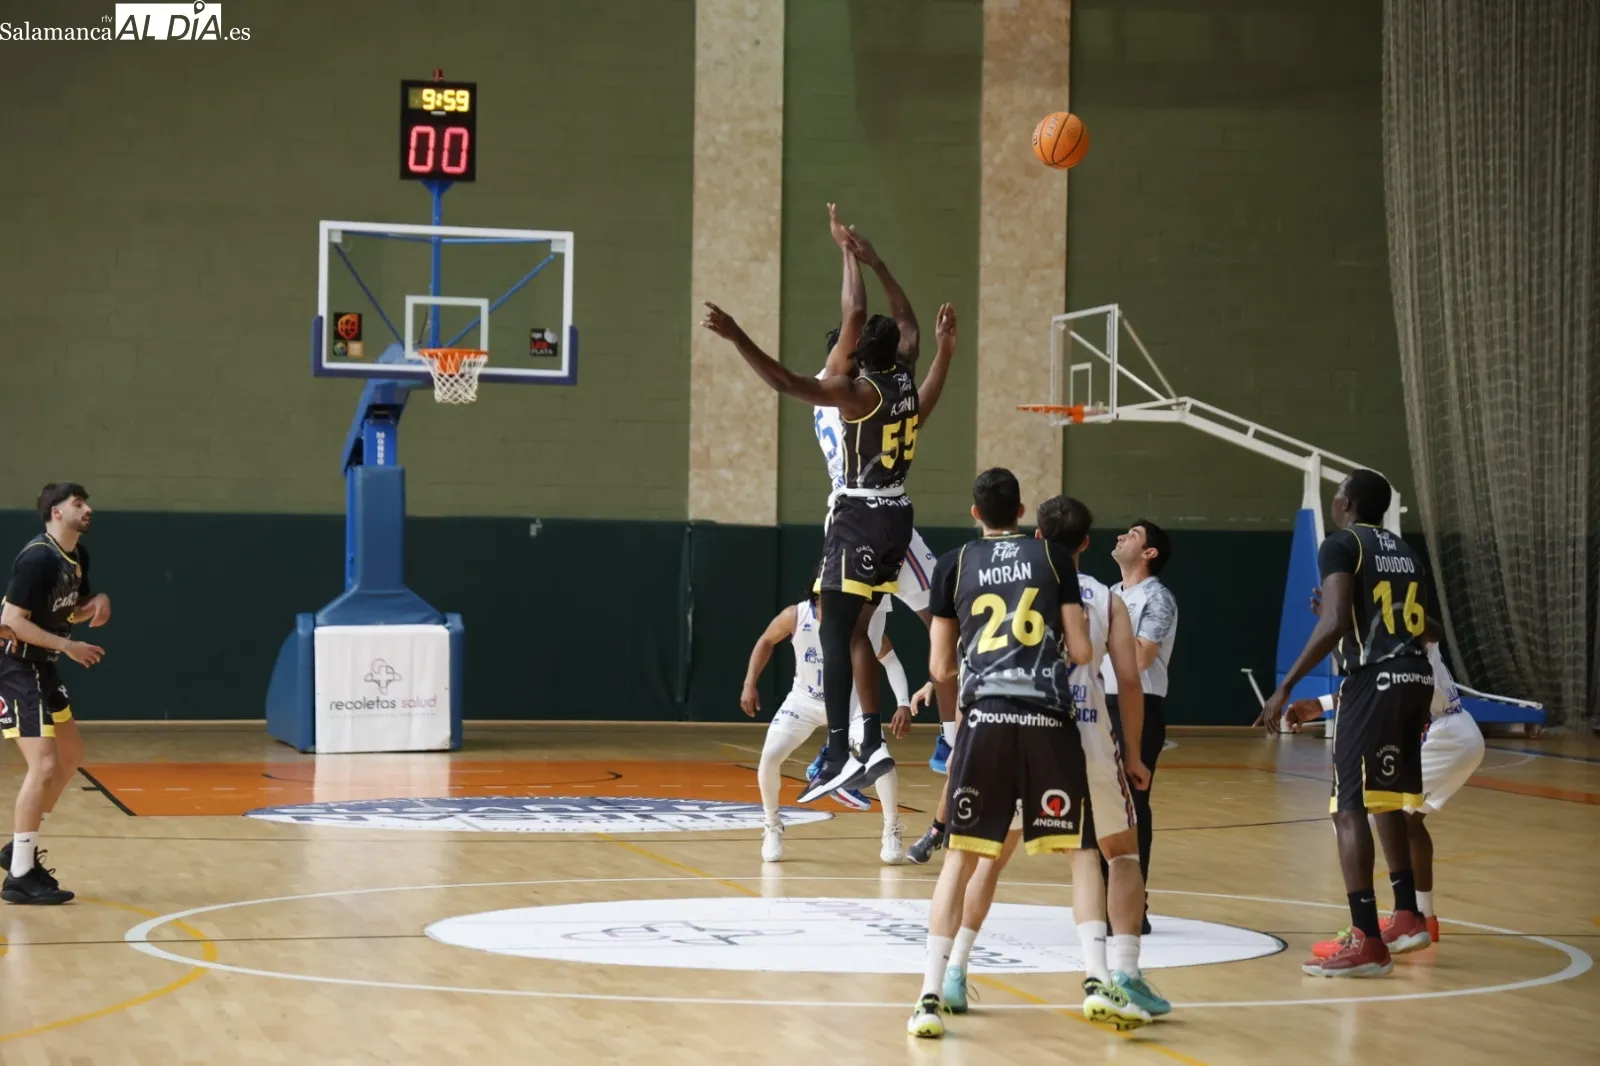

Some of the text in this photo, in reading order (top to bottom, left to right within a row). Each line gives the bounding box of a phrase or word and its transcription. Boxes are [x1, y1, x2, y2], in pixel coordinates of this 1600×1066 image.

[422, 88, 470, 112] 9:59
[408, 125, 469, 174] 00
[880, 414, 919, 470] 55
[978, 560, 1032, 587] MORÁN
[1374, 555, 1415, 573] DOUDOU
[971, 587, 1045, 655] 26
[1373, 580, 1425, 637] 16
[329, 694, 437, 711] recoletas salud
[1032, 818, 1074, 830] ANDRES
